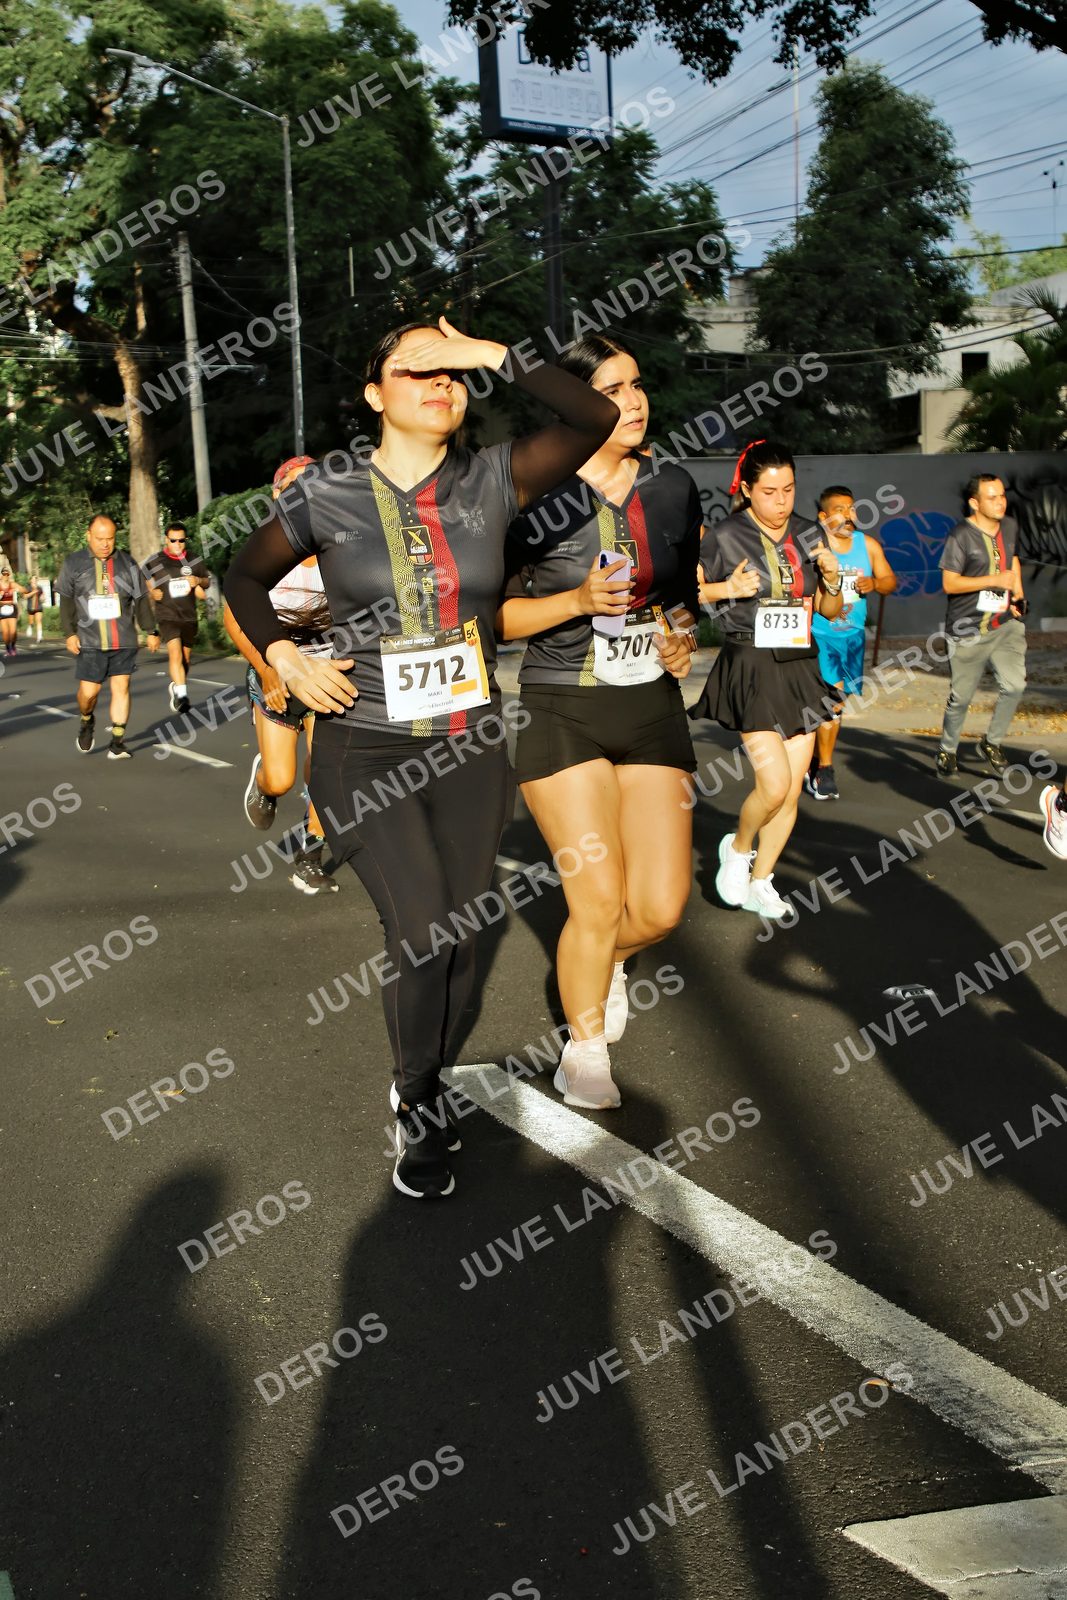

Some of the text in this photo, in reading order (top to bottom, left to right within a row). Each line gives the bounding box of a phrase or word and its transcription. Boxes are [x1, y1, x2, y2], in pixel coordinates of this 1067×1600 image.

[763, 613, 799, 629] 8733
[466, 628, 475, 639] 5K
[606, 632, 654, 662] 5707
[399, 655, 466, 691] 5712
